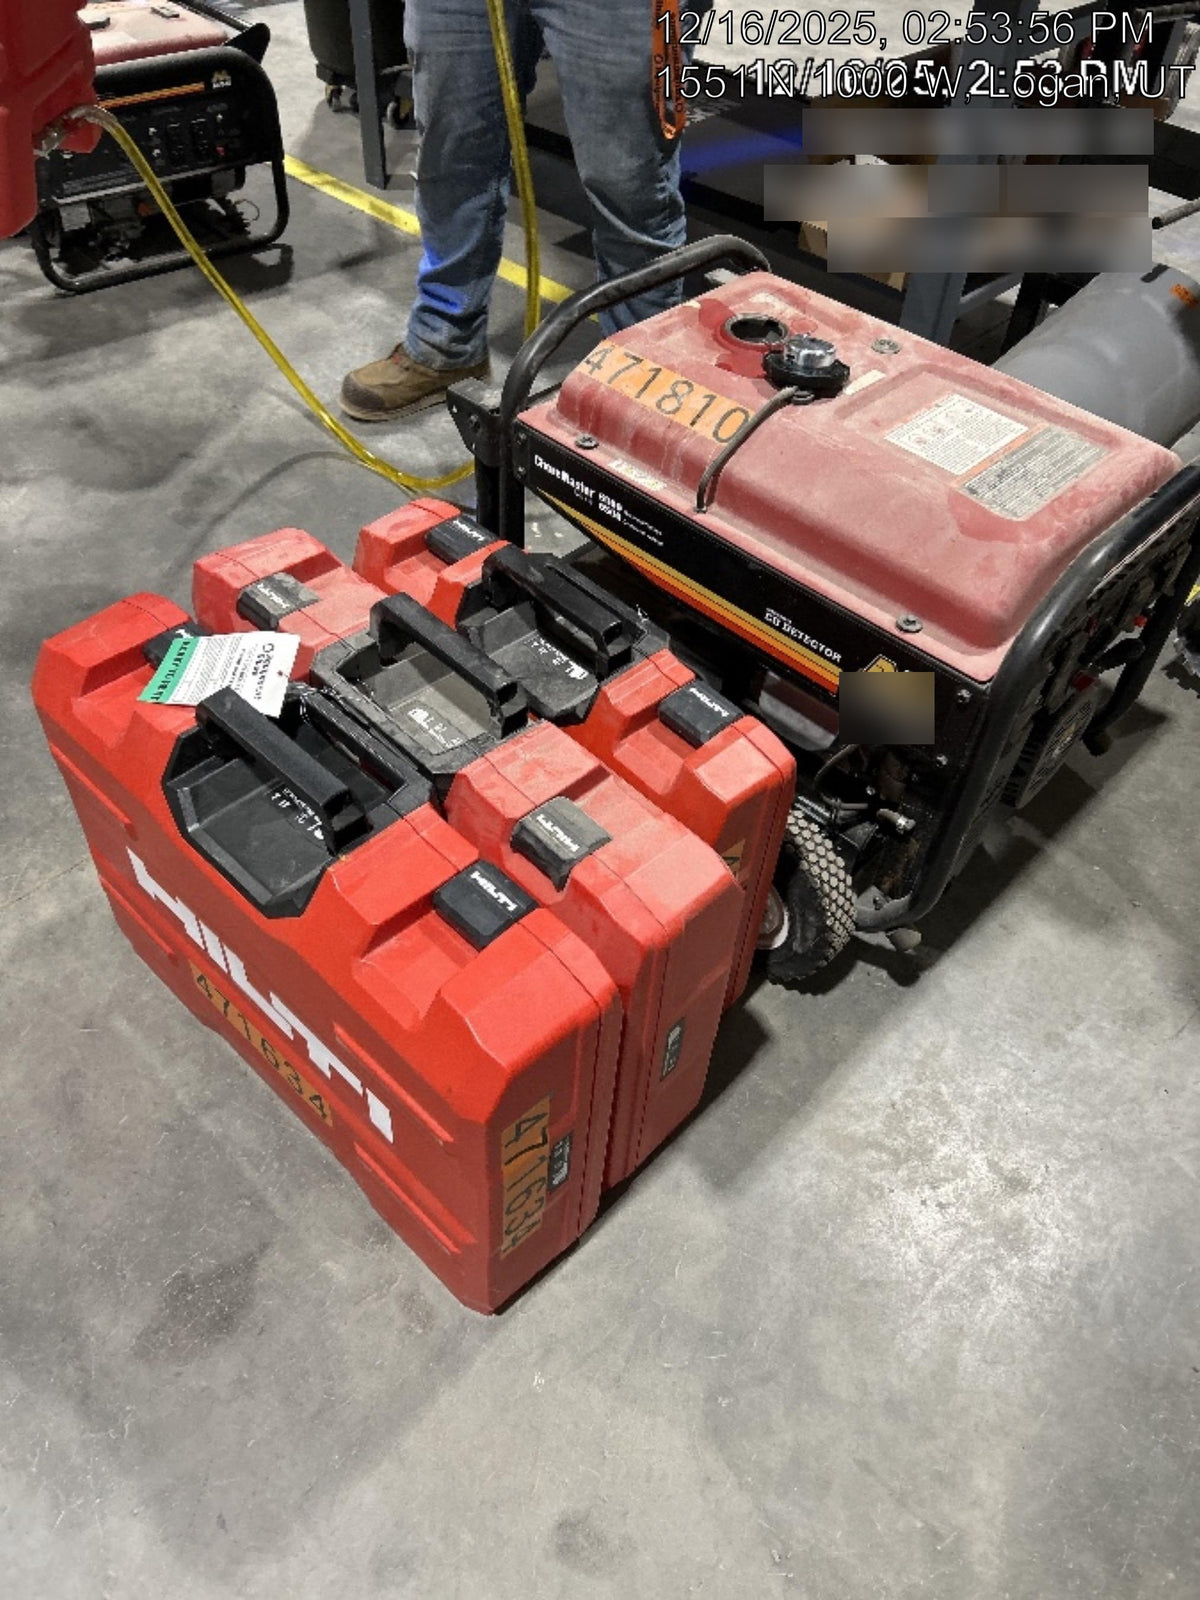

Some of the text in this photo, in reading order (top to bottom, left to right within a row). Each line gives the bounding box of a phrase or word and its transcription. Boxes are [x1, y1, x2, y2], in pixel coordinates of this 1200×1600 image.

[583, 343, 750, 444] 471810
[533, 453, 597, 500] ChoreMaster
[781, 620, 843, 664] DETECTOR
[126, 846, 394, 1144] HILTI
[196, 973, 329, 1121] 471634
[503, 1111, 549, 1254] 471634
